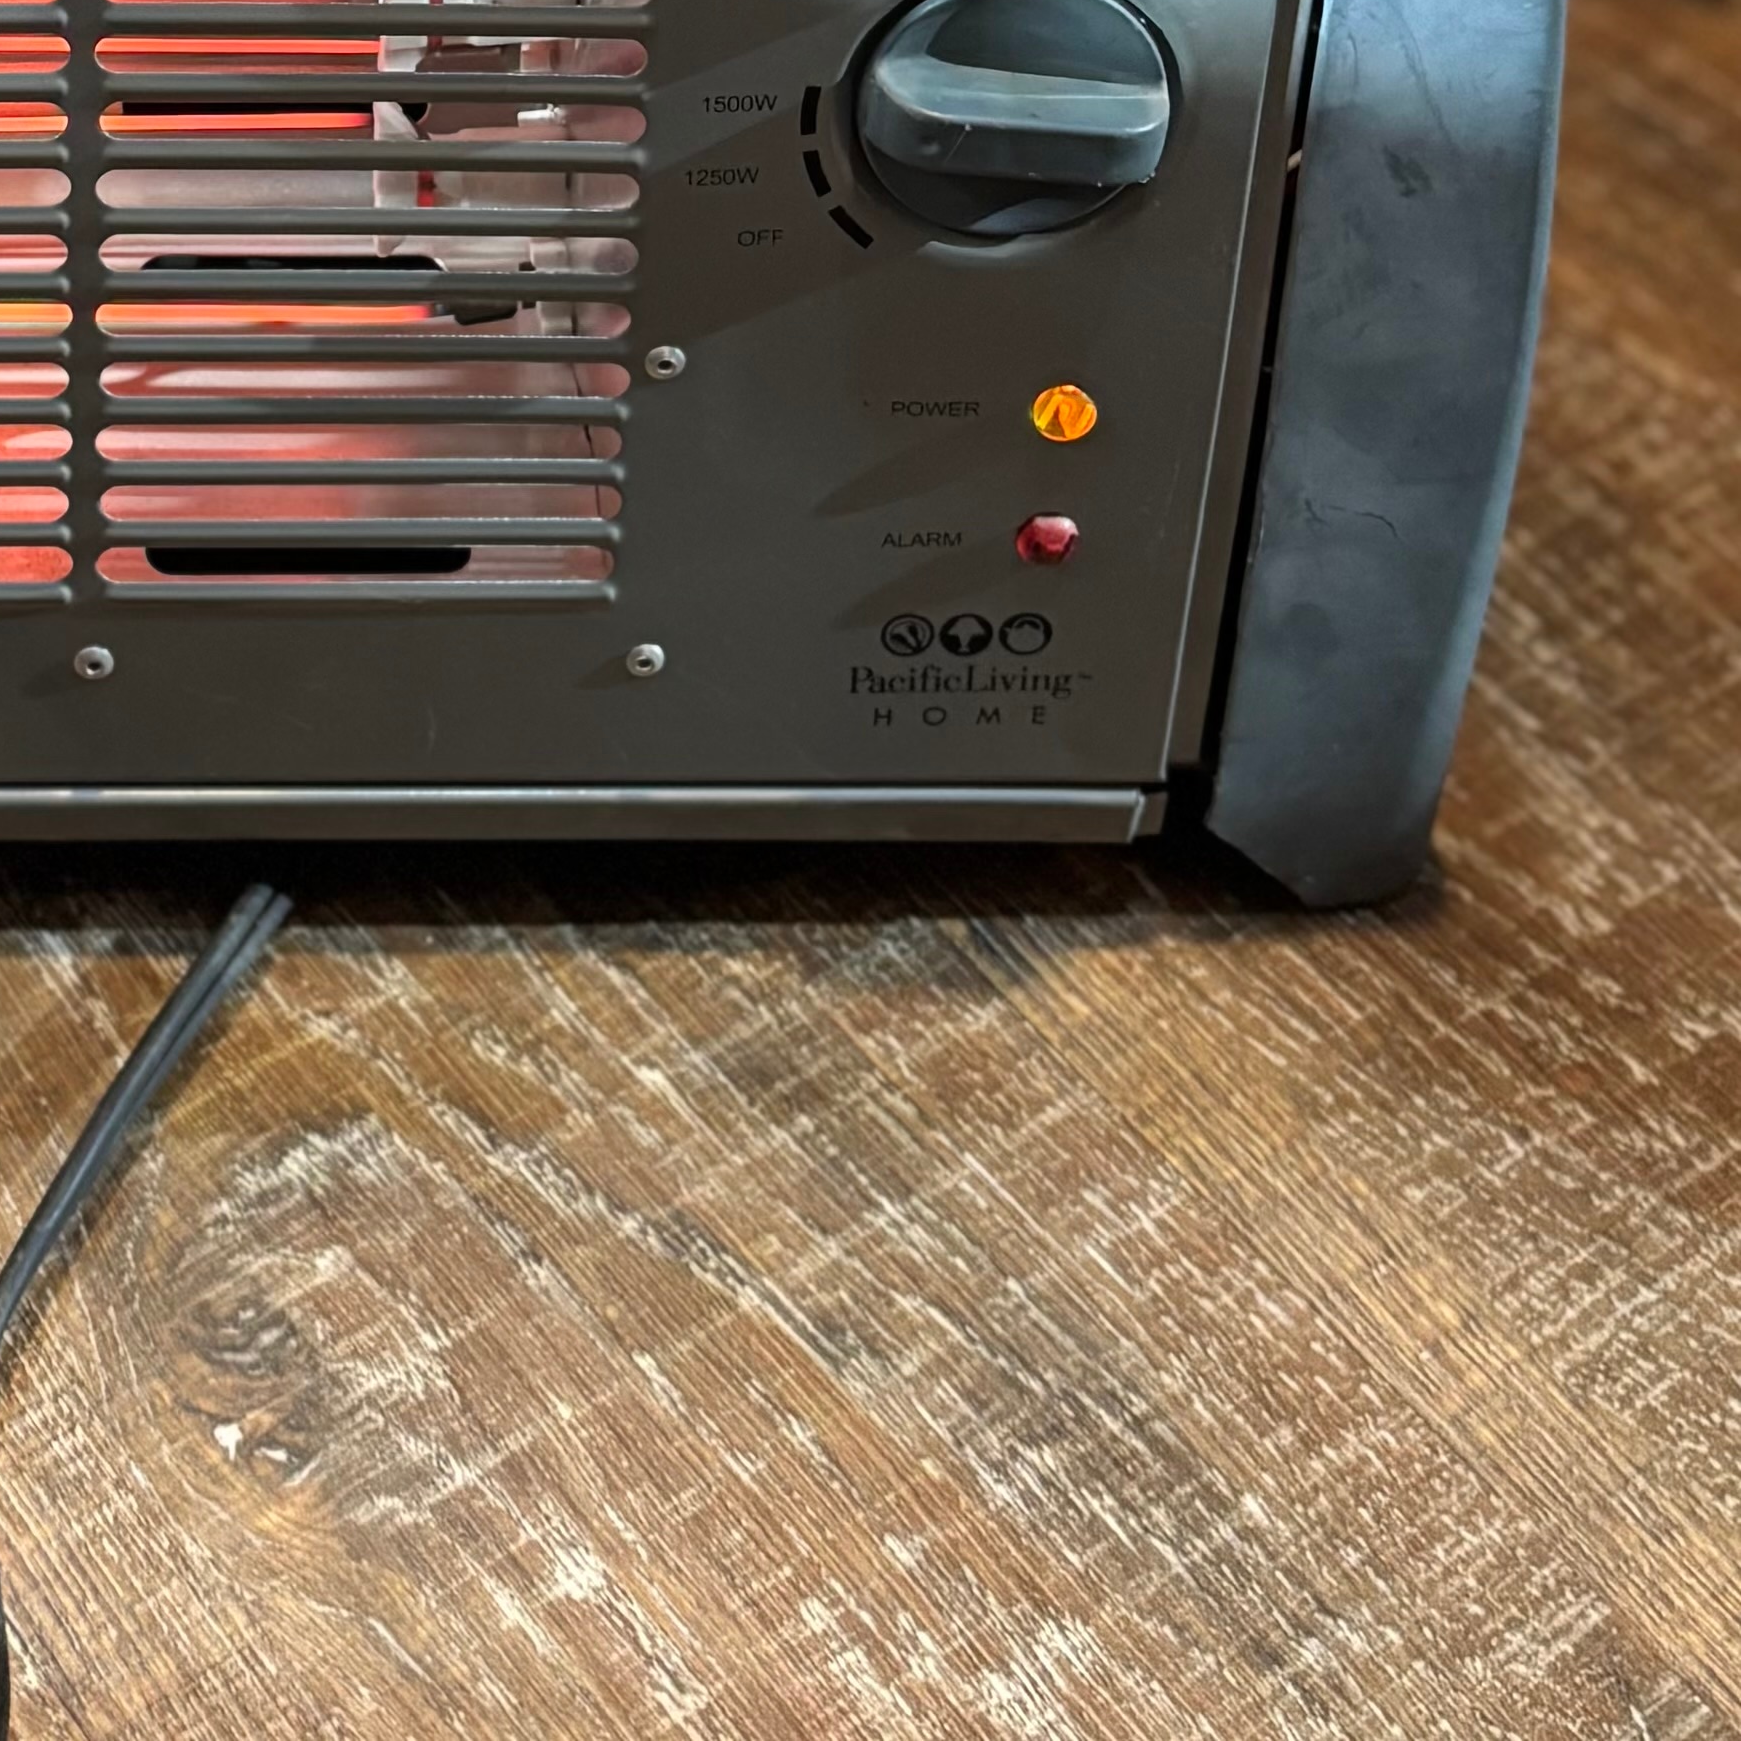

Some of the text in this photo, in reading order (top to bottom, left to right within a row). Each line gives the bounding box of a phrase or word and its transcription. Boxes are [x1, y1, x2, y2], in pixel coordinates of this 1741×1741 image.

[702, 93, 778, 113] 1500W
[685, 166, 760, 187] 1250W
[736, 228, 785, 247] OFF
[890, 400, 981, 418] POWER
[880, 531, 963, 549] ALARM
[872, 706, 1048, 728] HOME
